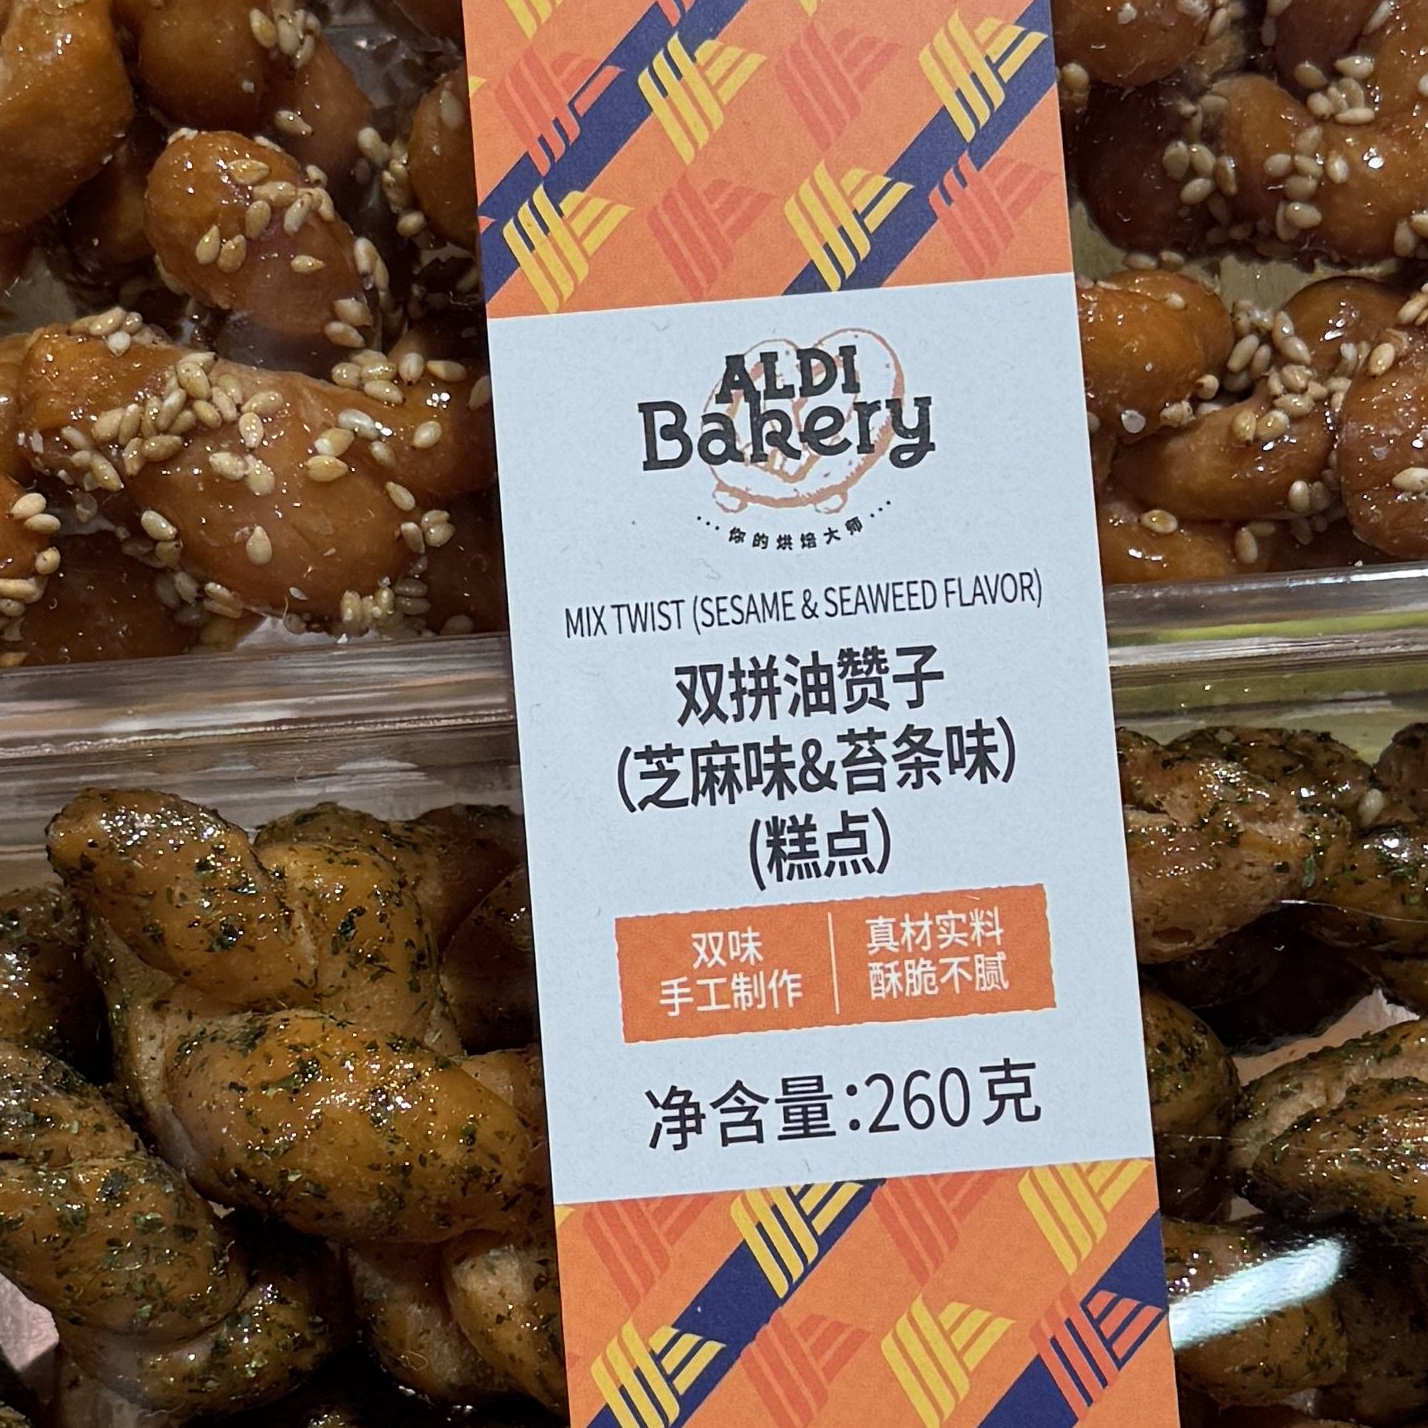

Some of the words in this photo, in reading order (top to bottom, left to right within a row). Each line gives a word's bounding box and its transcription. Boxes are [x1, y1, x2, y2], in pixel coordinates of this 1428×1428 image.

[714, 344, 862, 404] ALDI
[637, 390, 937, 472] Bakery
[728, 516, 864, 551] 你的烘焙大师
[565, 606, 608, 639] MIX
[610, 599, 686, 635] TWIST
[693, 591, 797, 636] (SESAME
[801, 588, 821, 620] &
[824, 579, 938, 618] SEAWEED
[944, 568, 1043, 609] FLAVOR)
[674, 644, 946, 727] 双拼油赞子
[617, 716, 1017, 813] (芝麻味&苔条味)
[749, 807, 892, 892] (糕点)
[691, 926, 765, 970] 双味
[865, 906, 1005, 956] 真材实料
[658, 968, 805, 1018] 手工制作
[868, 951, 1010, 1000] 酥脆不腻
[645, 1056, 1043, 1153] 净含量:260克
